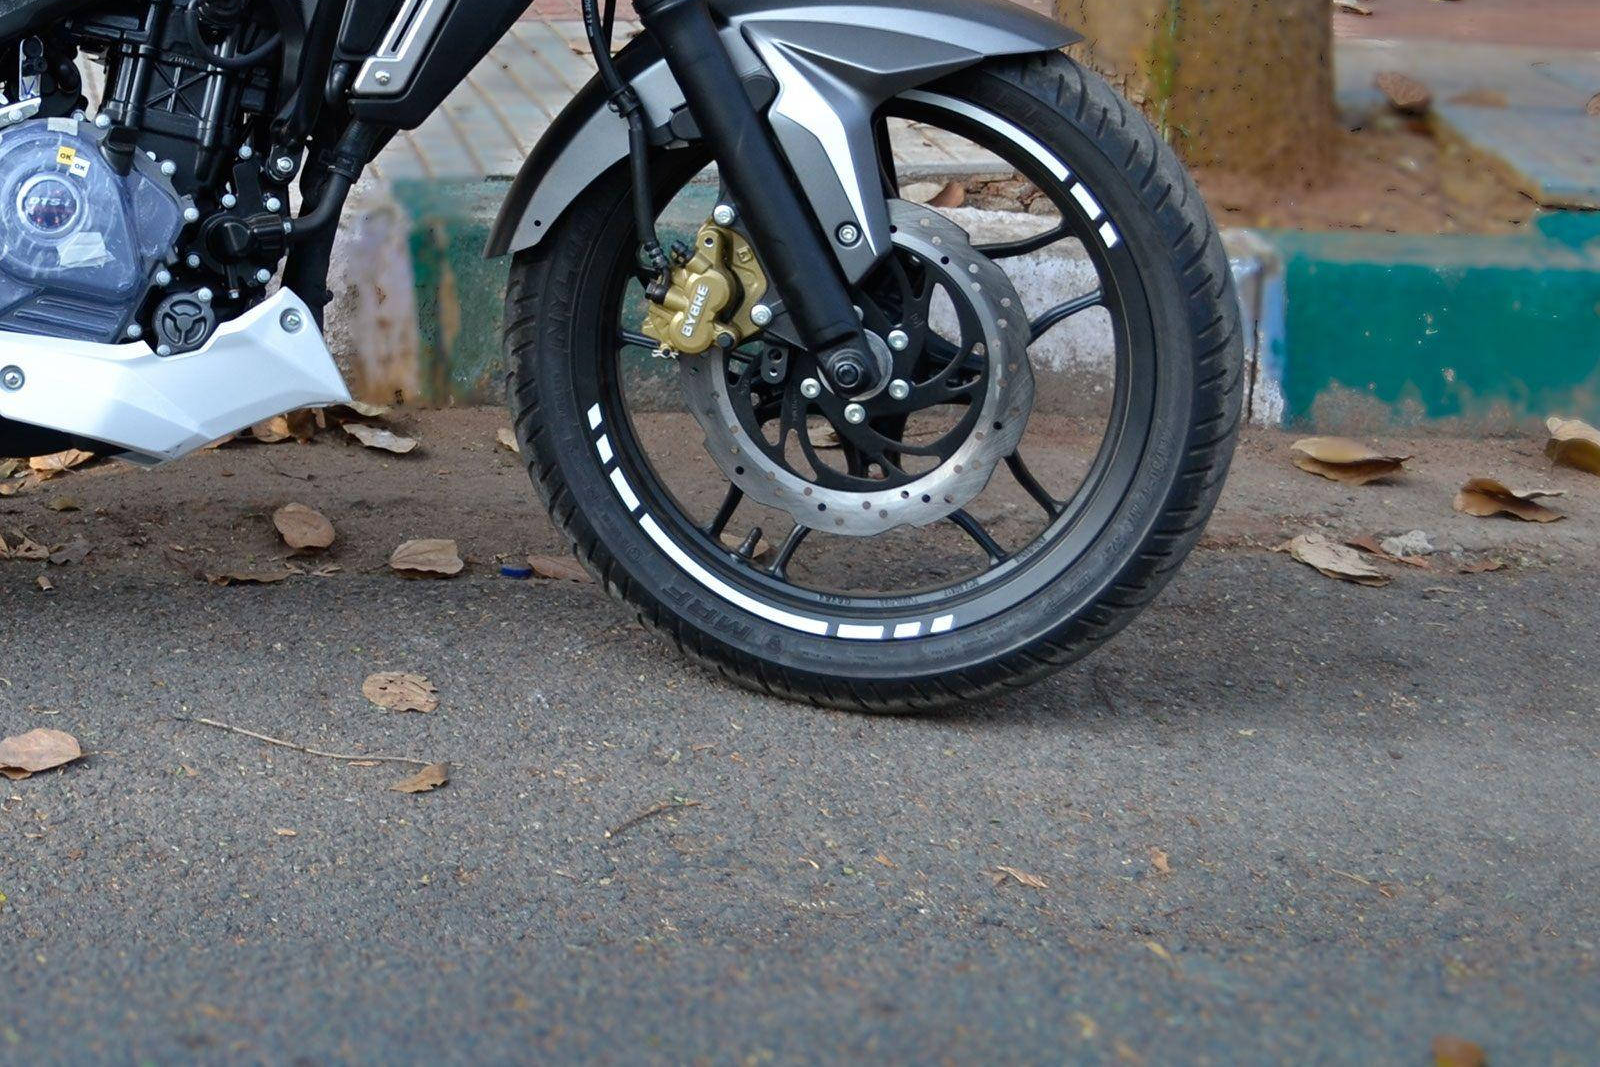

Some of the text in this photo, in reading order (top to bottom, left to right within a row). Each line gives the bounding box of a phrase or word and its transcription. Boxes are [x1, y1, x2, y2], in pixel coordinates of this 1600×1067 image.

[60, 152, 72, 161] OK
[74, 163, 86, 172] OK
[680, 283, 710, 338] BYBRE
